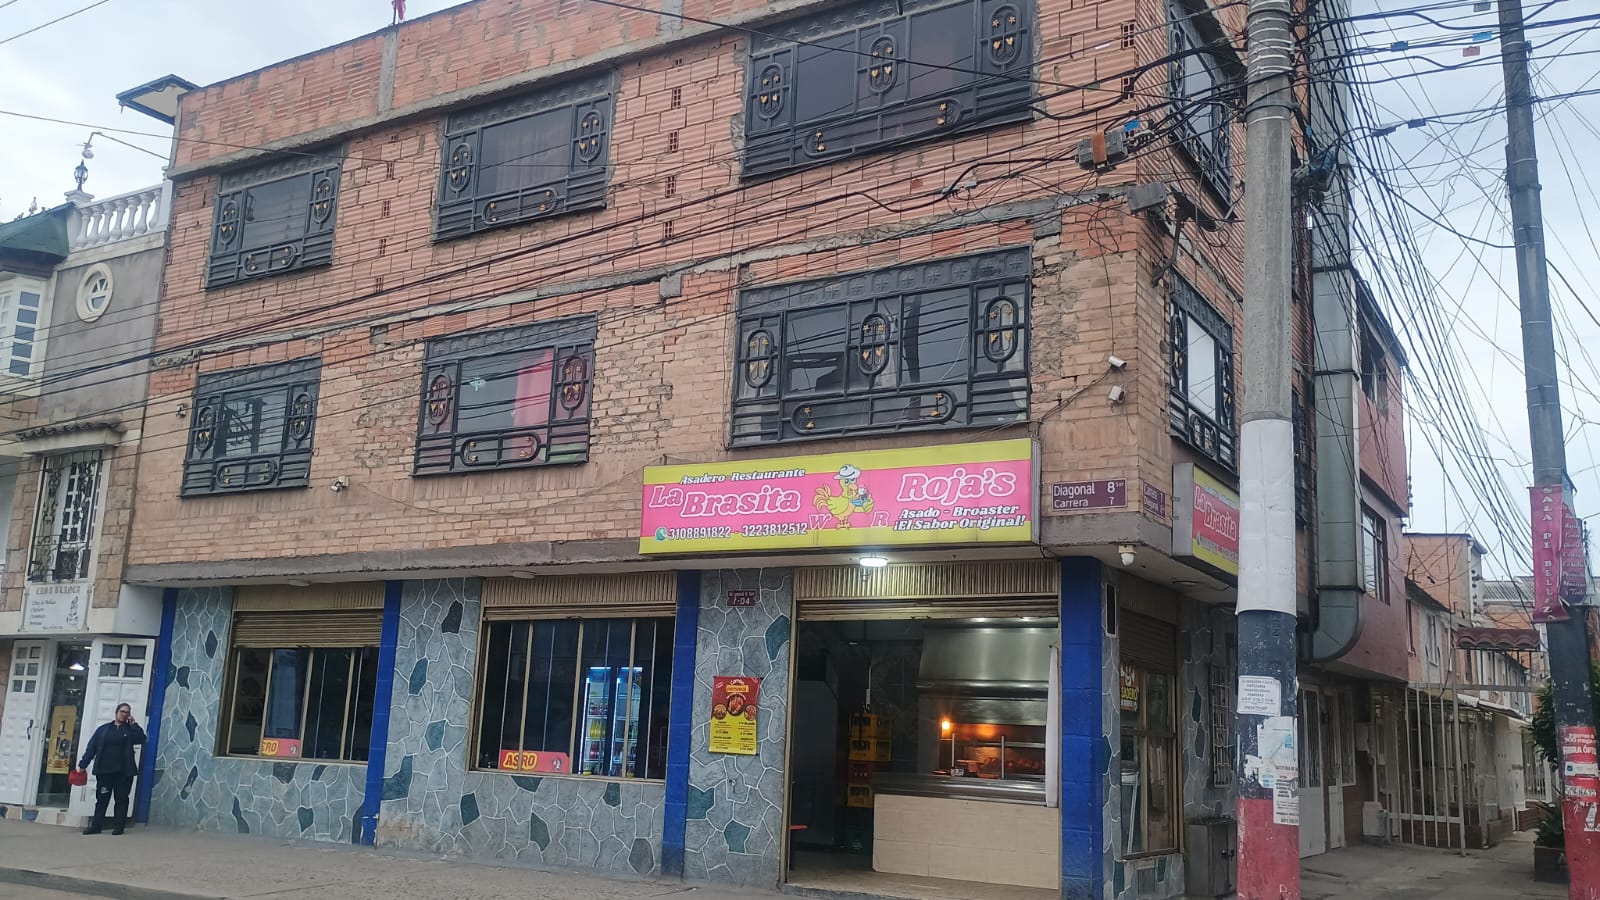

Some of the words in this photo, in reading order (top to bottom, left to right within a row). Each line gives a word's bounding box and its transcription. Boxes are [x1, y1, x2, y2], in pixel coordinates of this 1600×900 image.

[680, 472, 726, 485] Asadero
[731, 468, 806, 481] Restaurante
[897, 467, 1017, 506] Roja's
[1053, 482, 1096, 499] Diagonal
[1107, 481, 1115, 493] 8
[649, 485, 684, 508] La
[680, 485, 802, 517] Brasita
[1053, 498, 1089, 509] Carrera
[1109, 497, 1114, 505] 7
[1542, 487, 1553, 521] SALA
[809, 513, 832, 529] W
[871, 511, 890, 528] R
[899, 507, 941, 519] Asado
[952, 505, 1020, 517] Broaster
[914, 519, 957, 530] Sabor
[959, 515, 1026, 530] Original!
[1204, 502, 1237, 541] Brasita
[669, 526, 731, 540] 3108891822
[742, 522, 808, 537] 3223812512
[1543, 532, 1552, 549] DE
